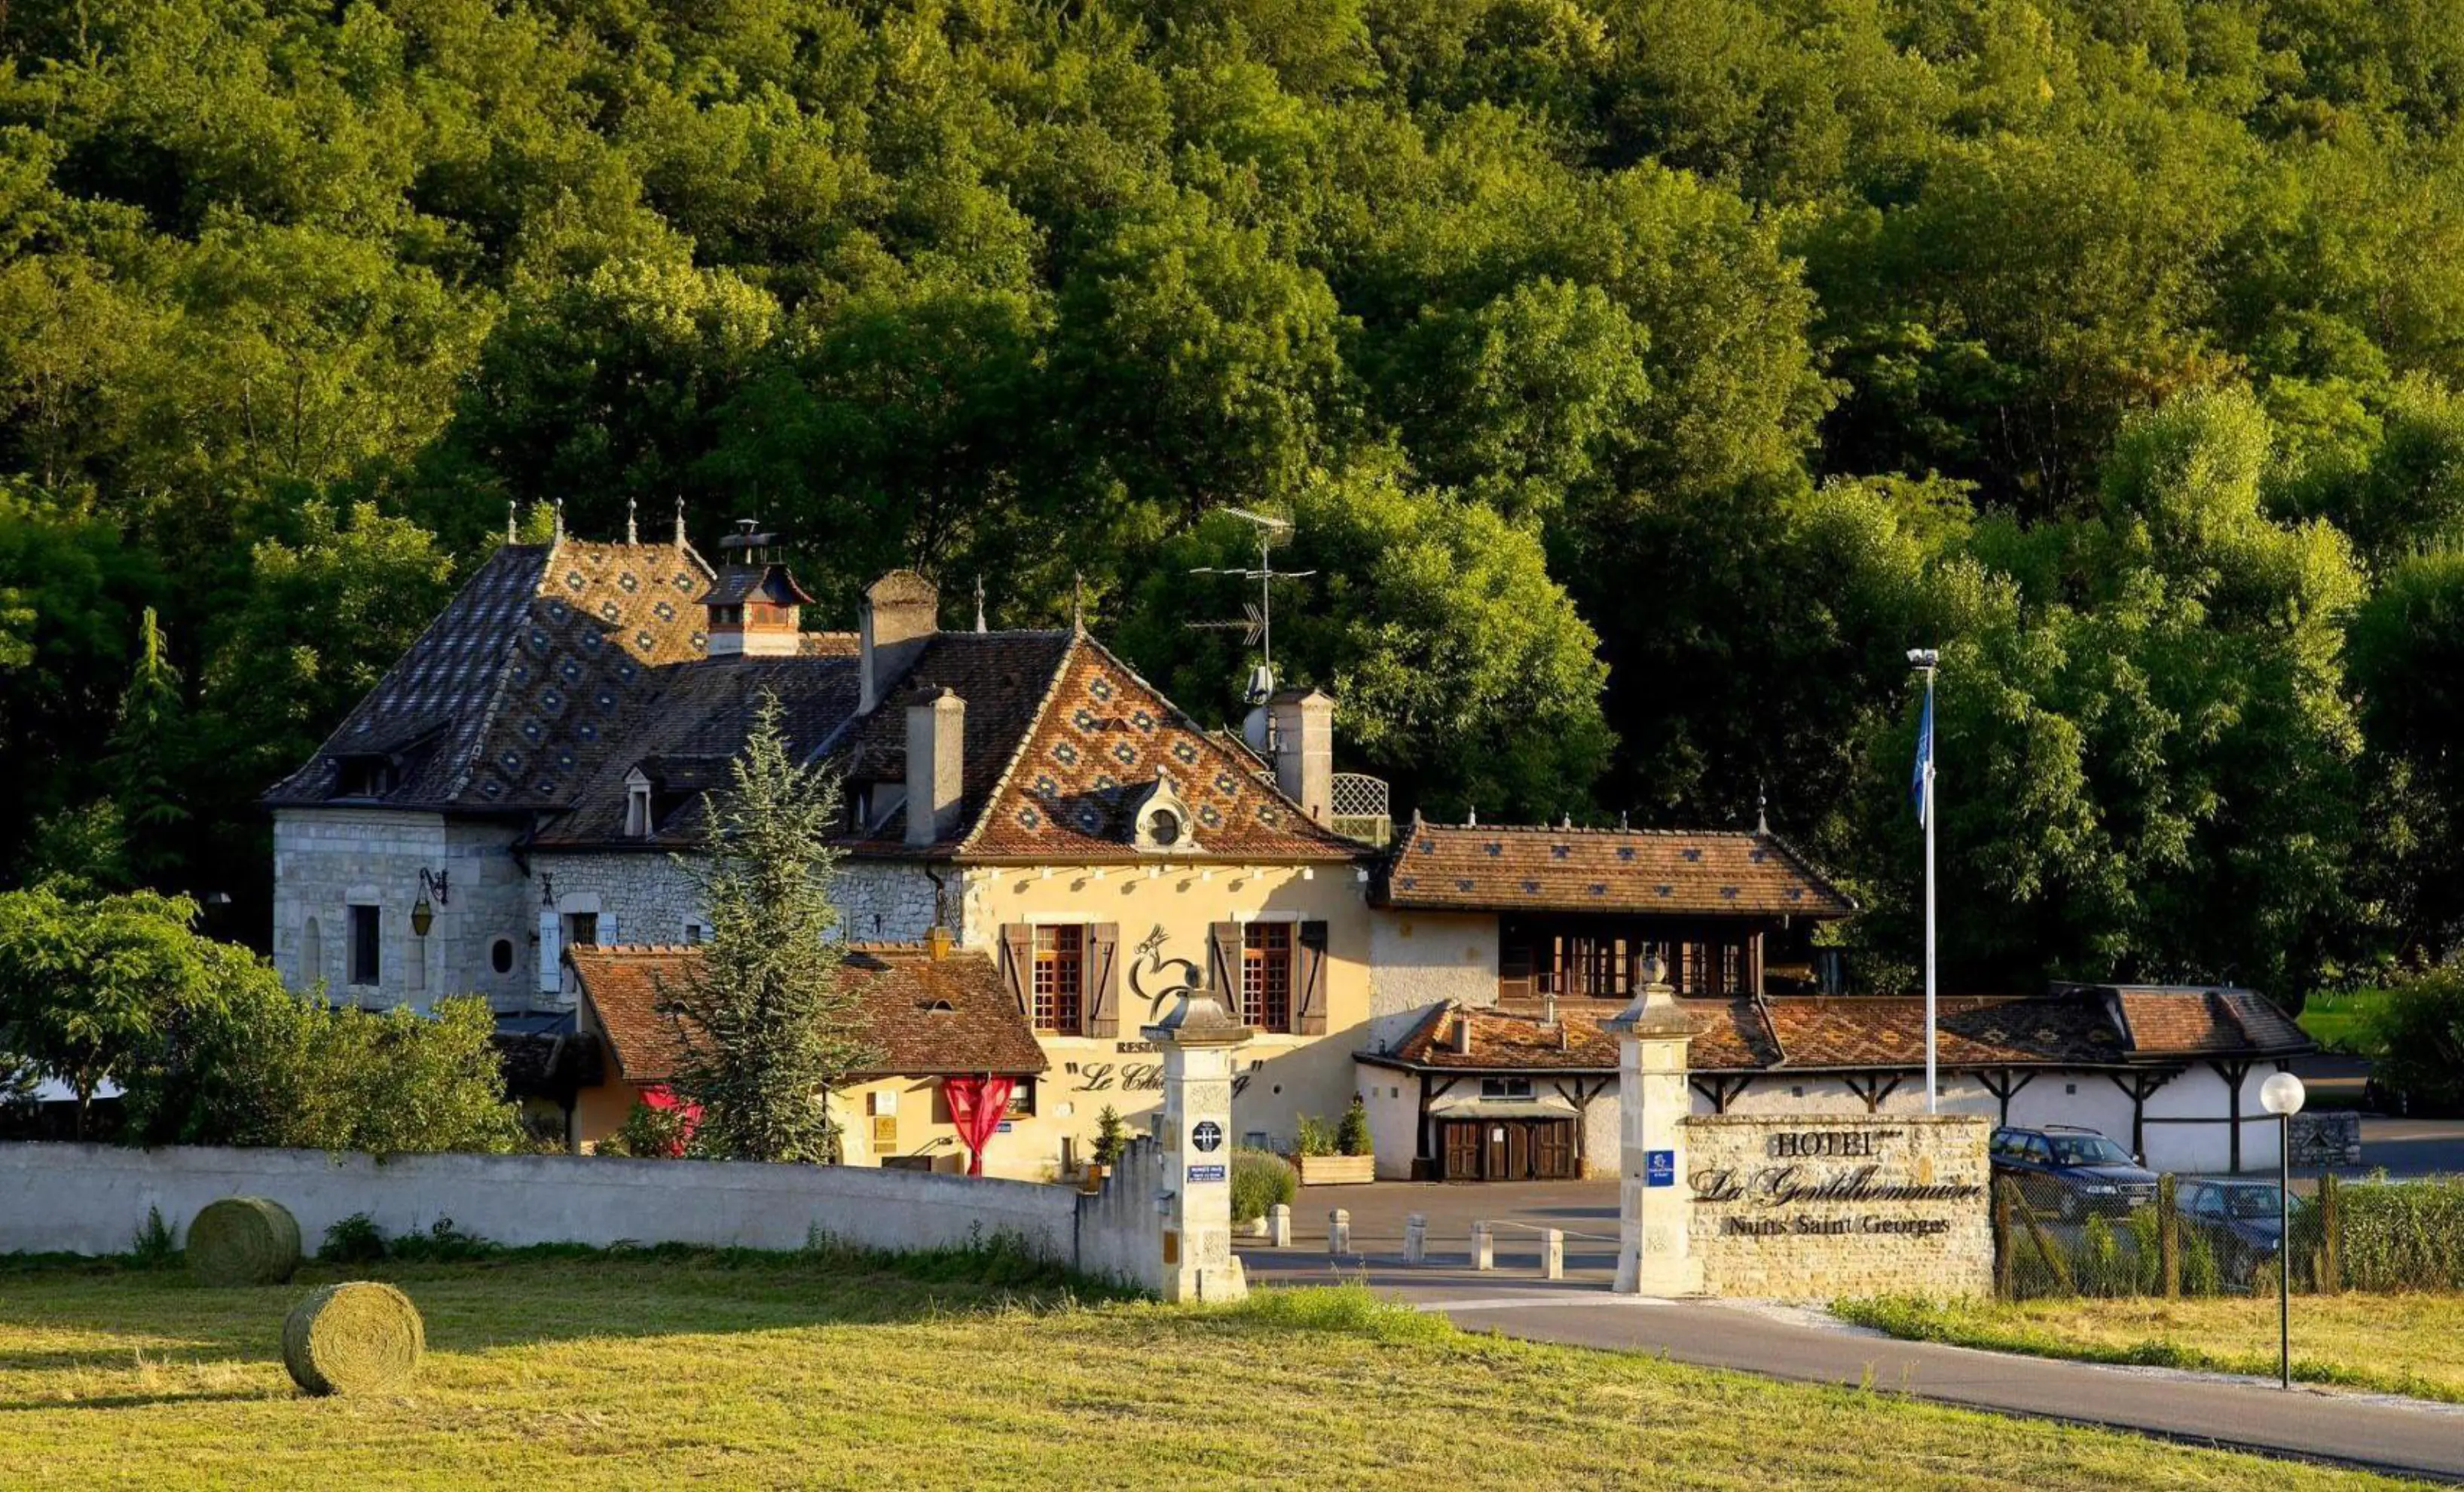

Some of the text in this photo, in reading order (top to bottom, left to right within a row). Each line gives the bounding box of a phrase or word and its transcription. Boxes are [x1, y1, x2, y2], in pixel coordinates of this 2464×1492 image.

[1116, 1041, 1163, 1053] RESTA
[1777, 1131, 1882, 1157] HOTEL
[1688, 1166, 1745, 1203] La
[1729, 1214, 1950, 1239] Nuits Saint Georges
